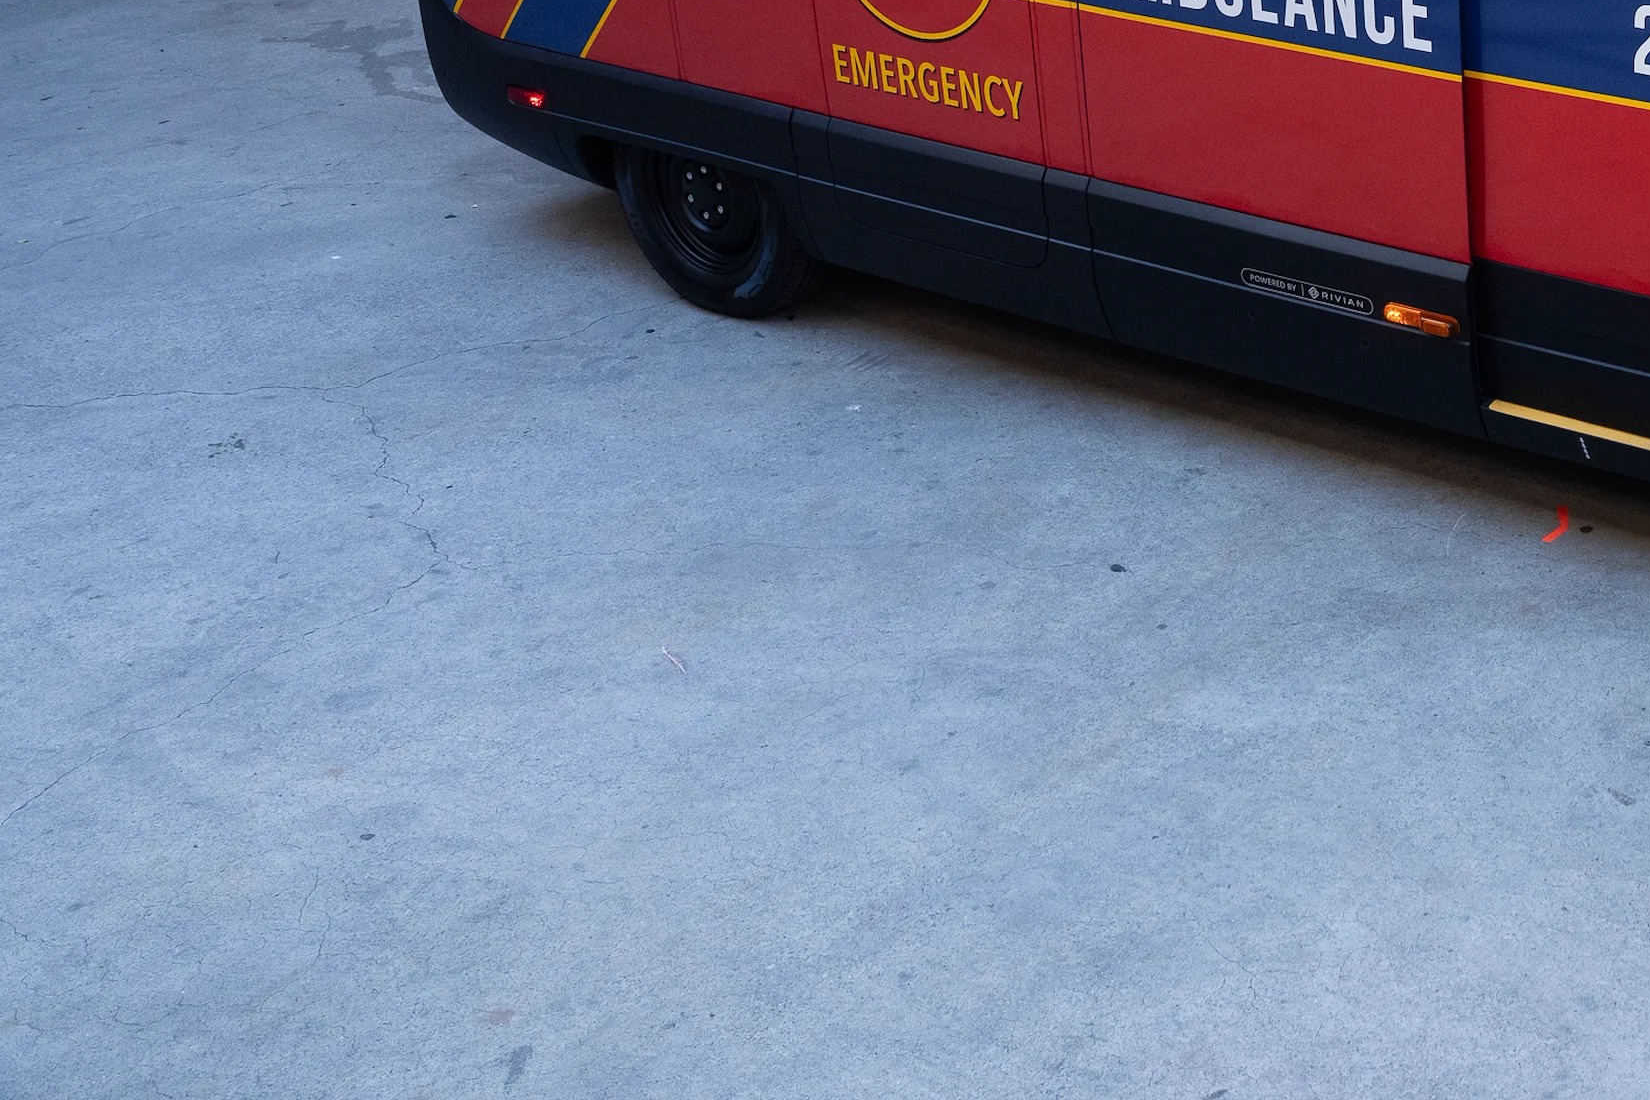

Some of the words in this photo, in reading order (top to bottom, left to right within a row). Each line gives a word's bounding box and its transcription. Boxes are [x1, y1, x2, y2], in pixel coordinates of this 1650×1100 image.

[832, 43, 1024, 121] EMERGENCY
[1249, 273, 1286, 290] POWERED
[1286, 282, 1297, 292] BY
[1321, 291, 1364, 309] RIVIAN
